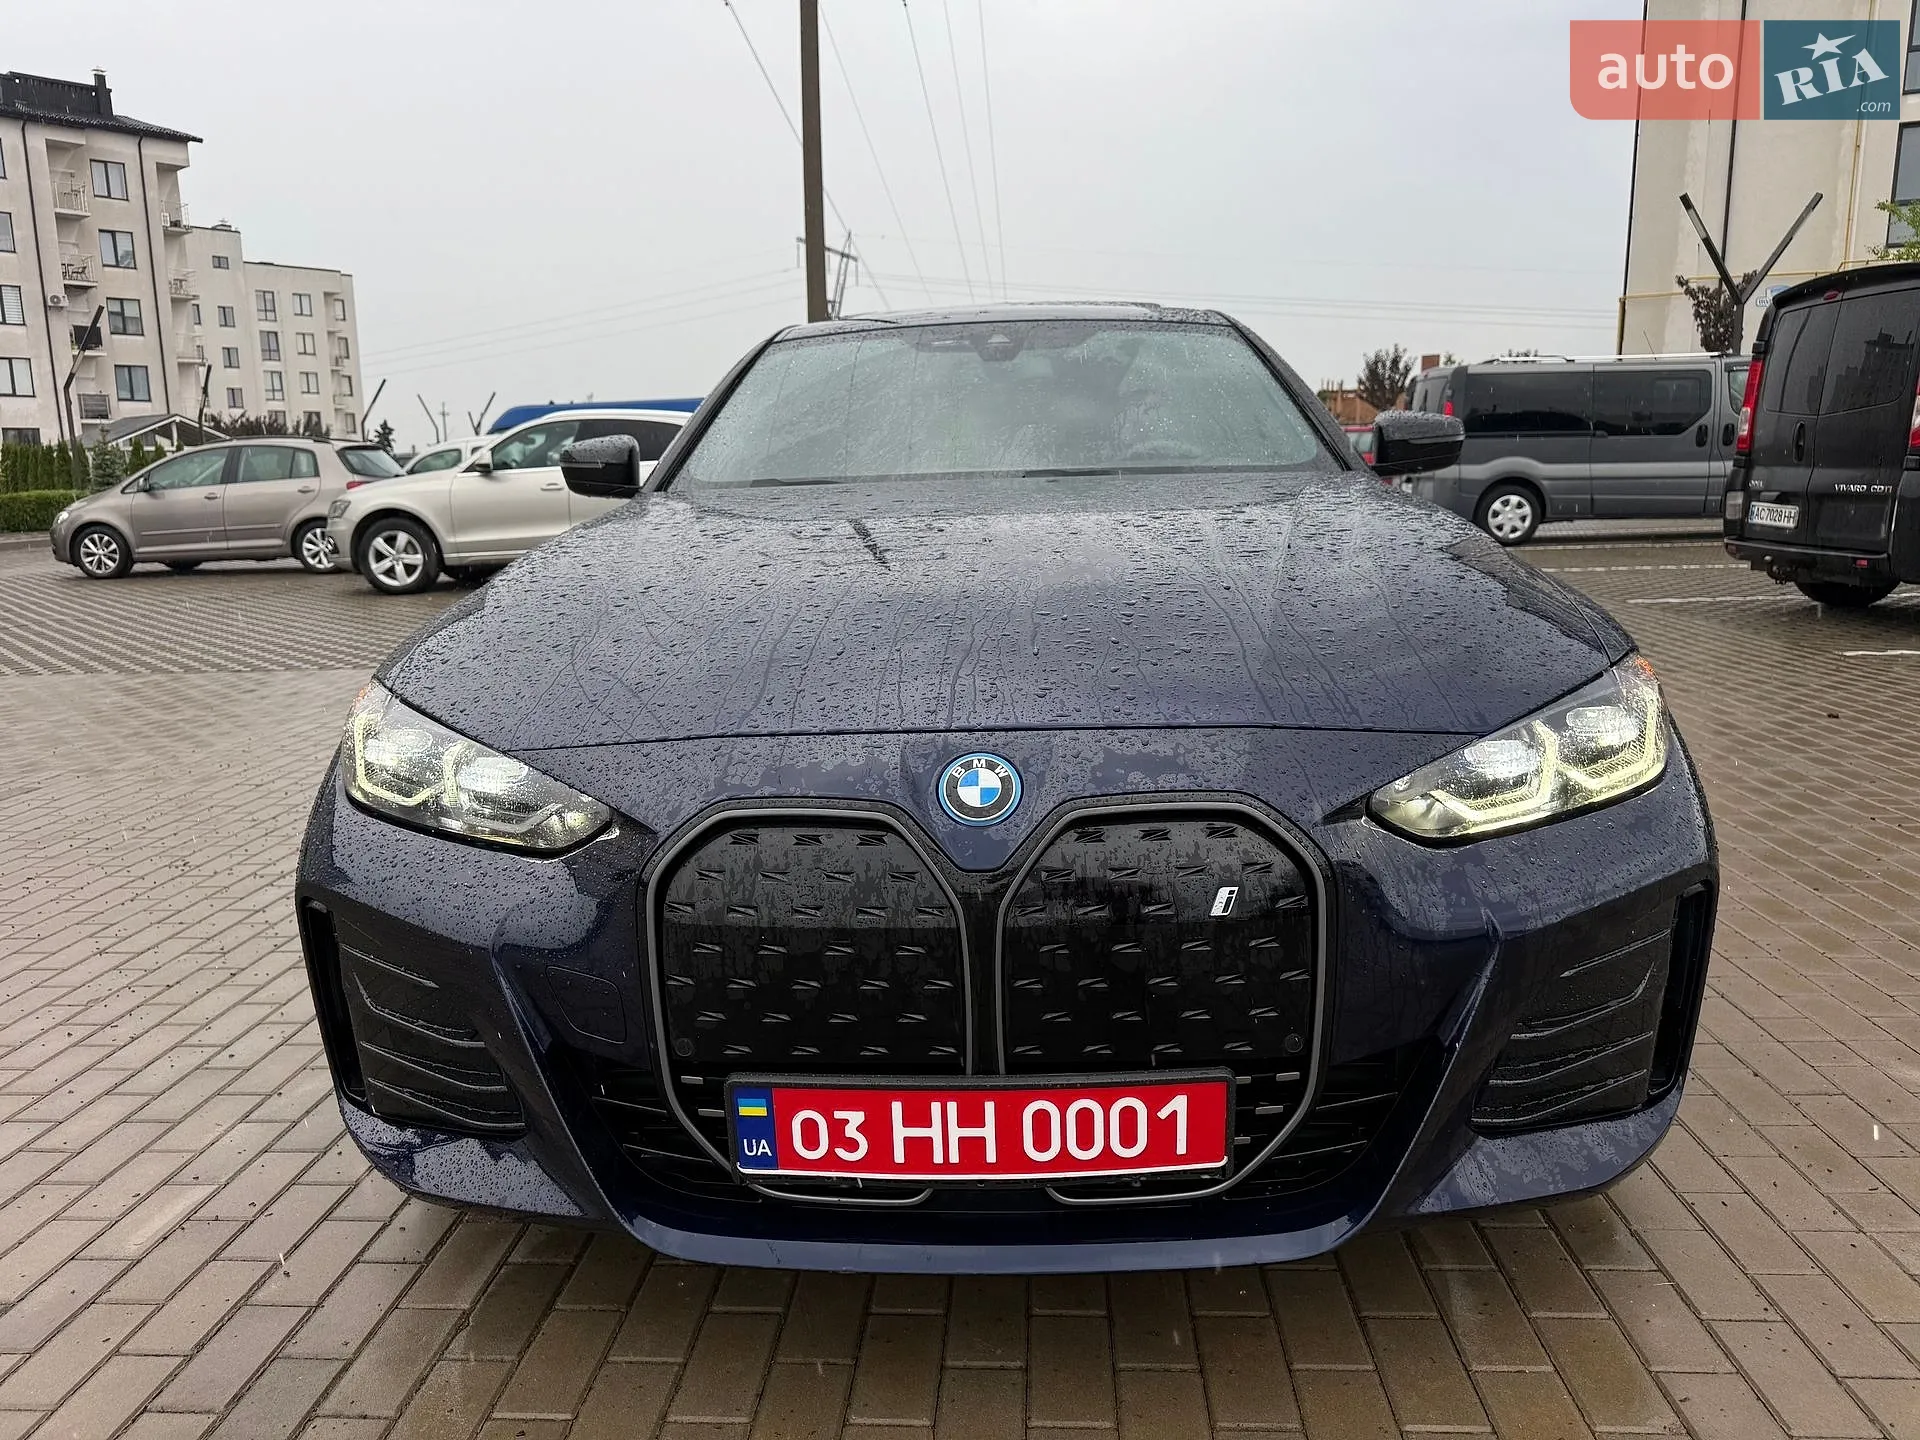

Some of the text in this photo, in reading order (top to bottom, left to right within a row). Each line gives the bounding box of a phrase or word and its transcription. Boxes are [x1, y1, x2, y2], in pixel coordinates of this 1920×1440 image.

[1834, 484, 1867, 492] VIVARO
[951, 758, 1009, 778] BMW
[791, 1094, 1189, 1164] 03 HH 0001
[743, 1138, 773, 1157] UA
